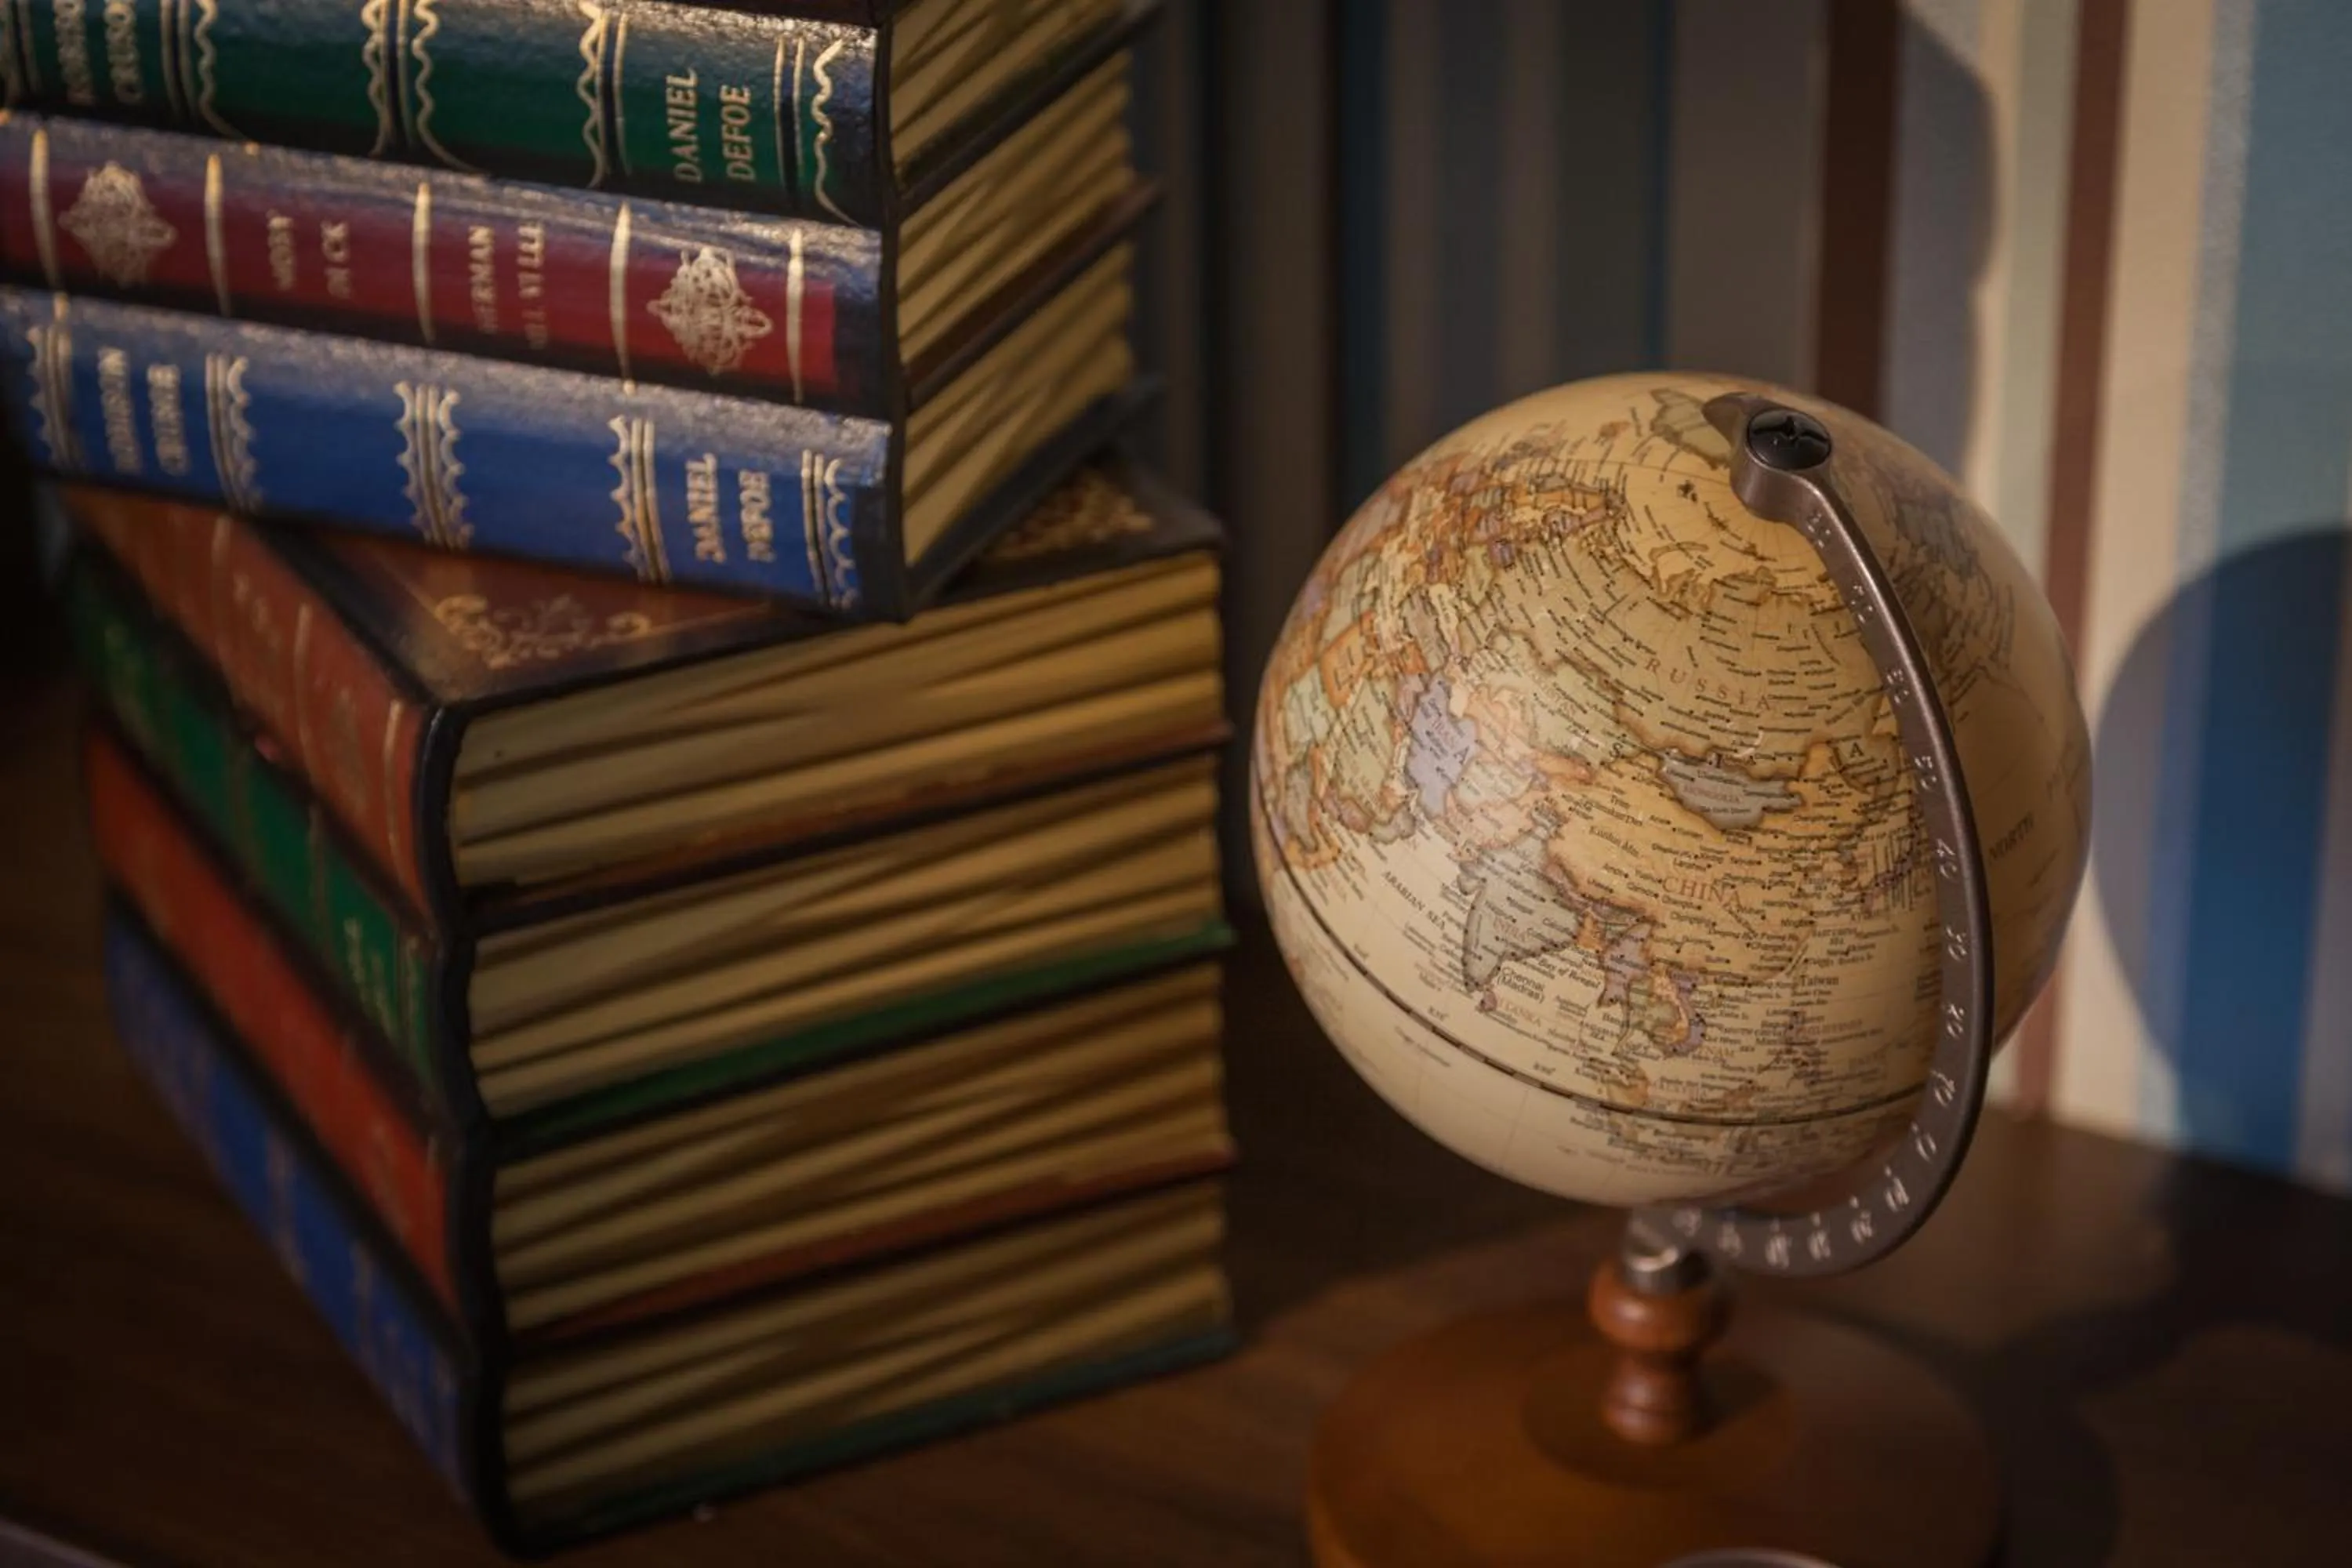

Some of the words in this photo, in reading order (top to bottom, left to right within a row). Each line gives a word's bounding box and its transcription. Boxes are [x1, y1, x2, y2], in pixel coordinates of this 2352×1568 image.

[666, 66, 703, 183] DANIEL
[719, 84, 757, 183] DEFOE
[685, 452, 728, 565] DANIEL
[1645, 657, 1770, 710] RUSSIA
[1381, 870, 1426, 912] ARABIAN
[1427, 909, 1447, 931] SEA
[1661, 876, 1746, 910] CHINA
[1799, 975, 1839, 985] Taiwan
